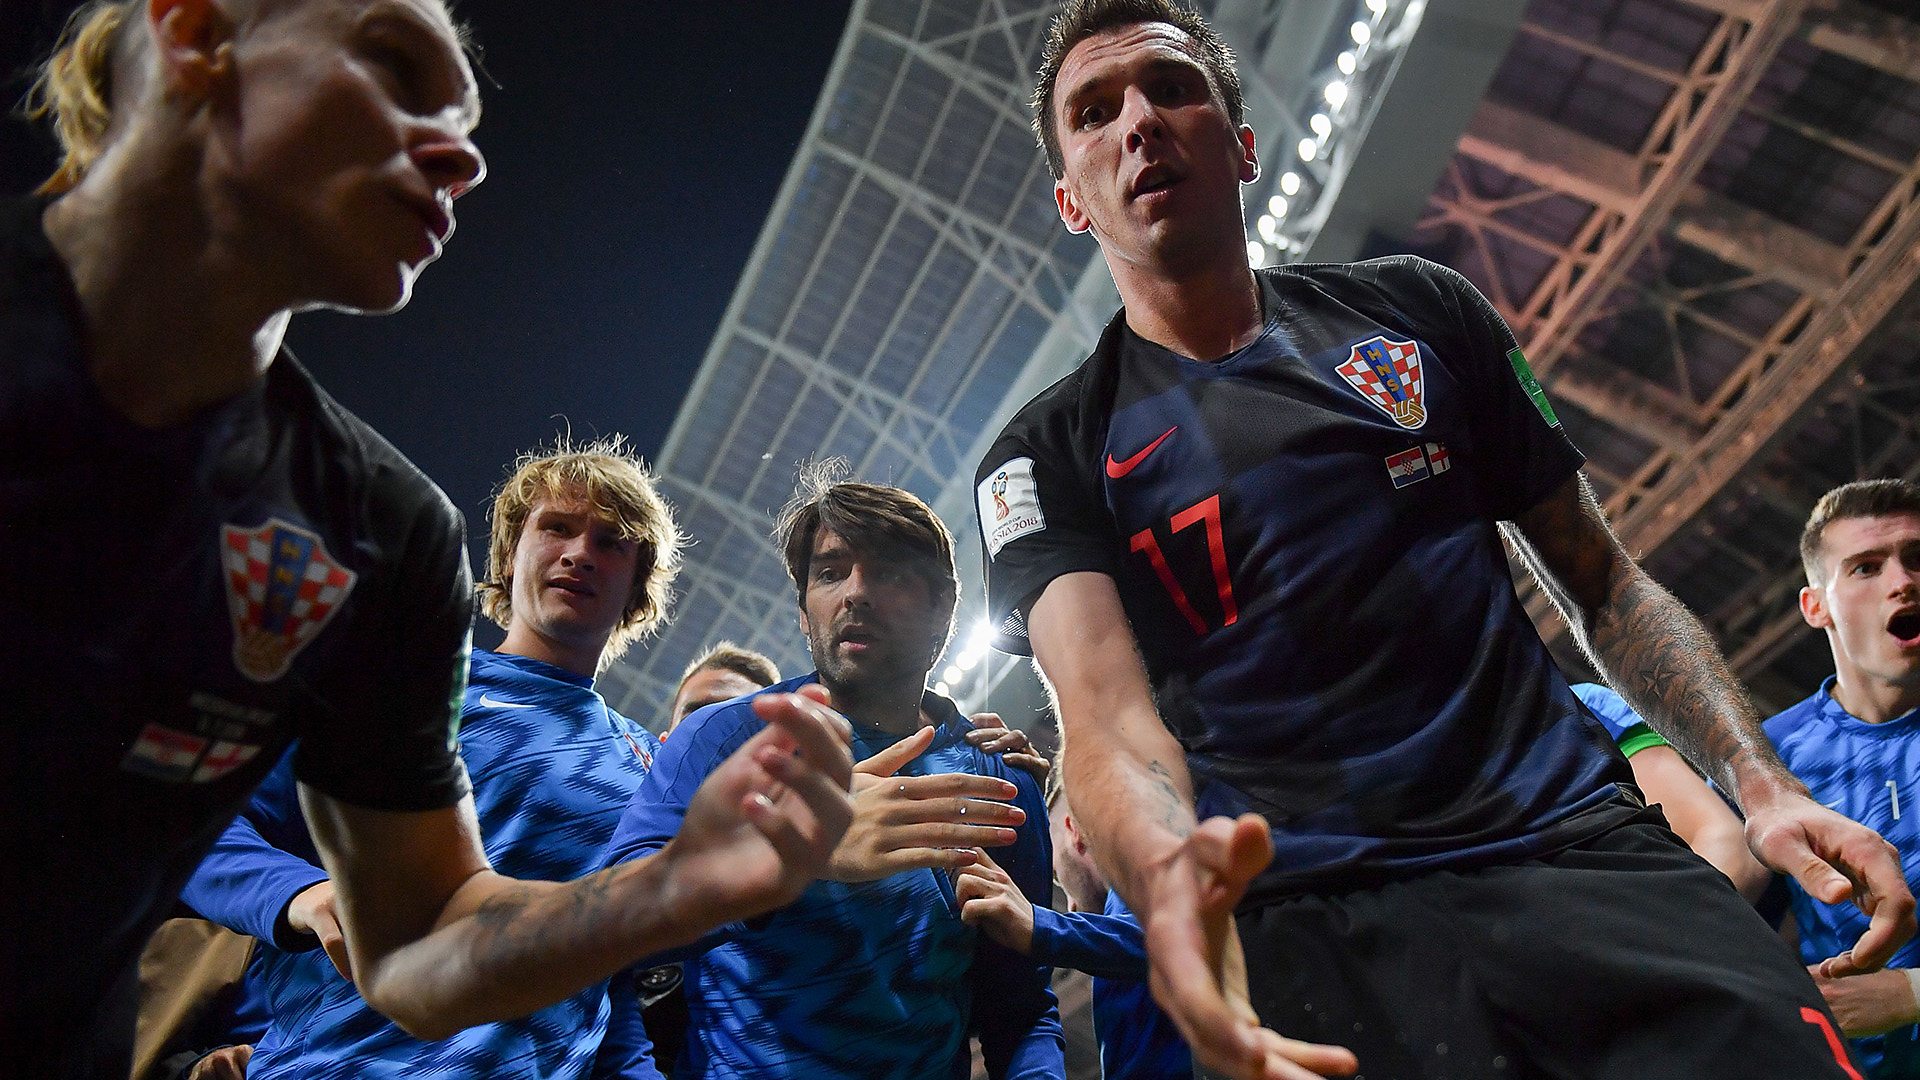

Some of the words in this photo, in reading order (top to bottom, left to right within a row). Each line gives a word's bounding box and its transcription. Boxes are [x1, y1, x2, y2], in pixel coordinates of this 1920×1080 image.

[1367, 348, 1400, 392] HNS
[1013, 516, 1038, 532] 2018
[1130, 493, 1238, 637] 17
[1885, 780, 1900, 820] 1
